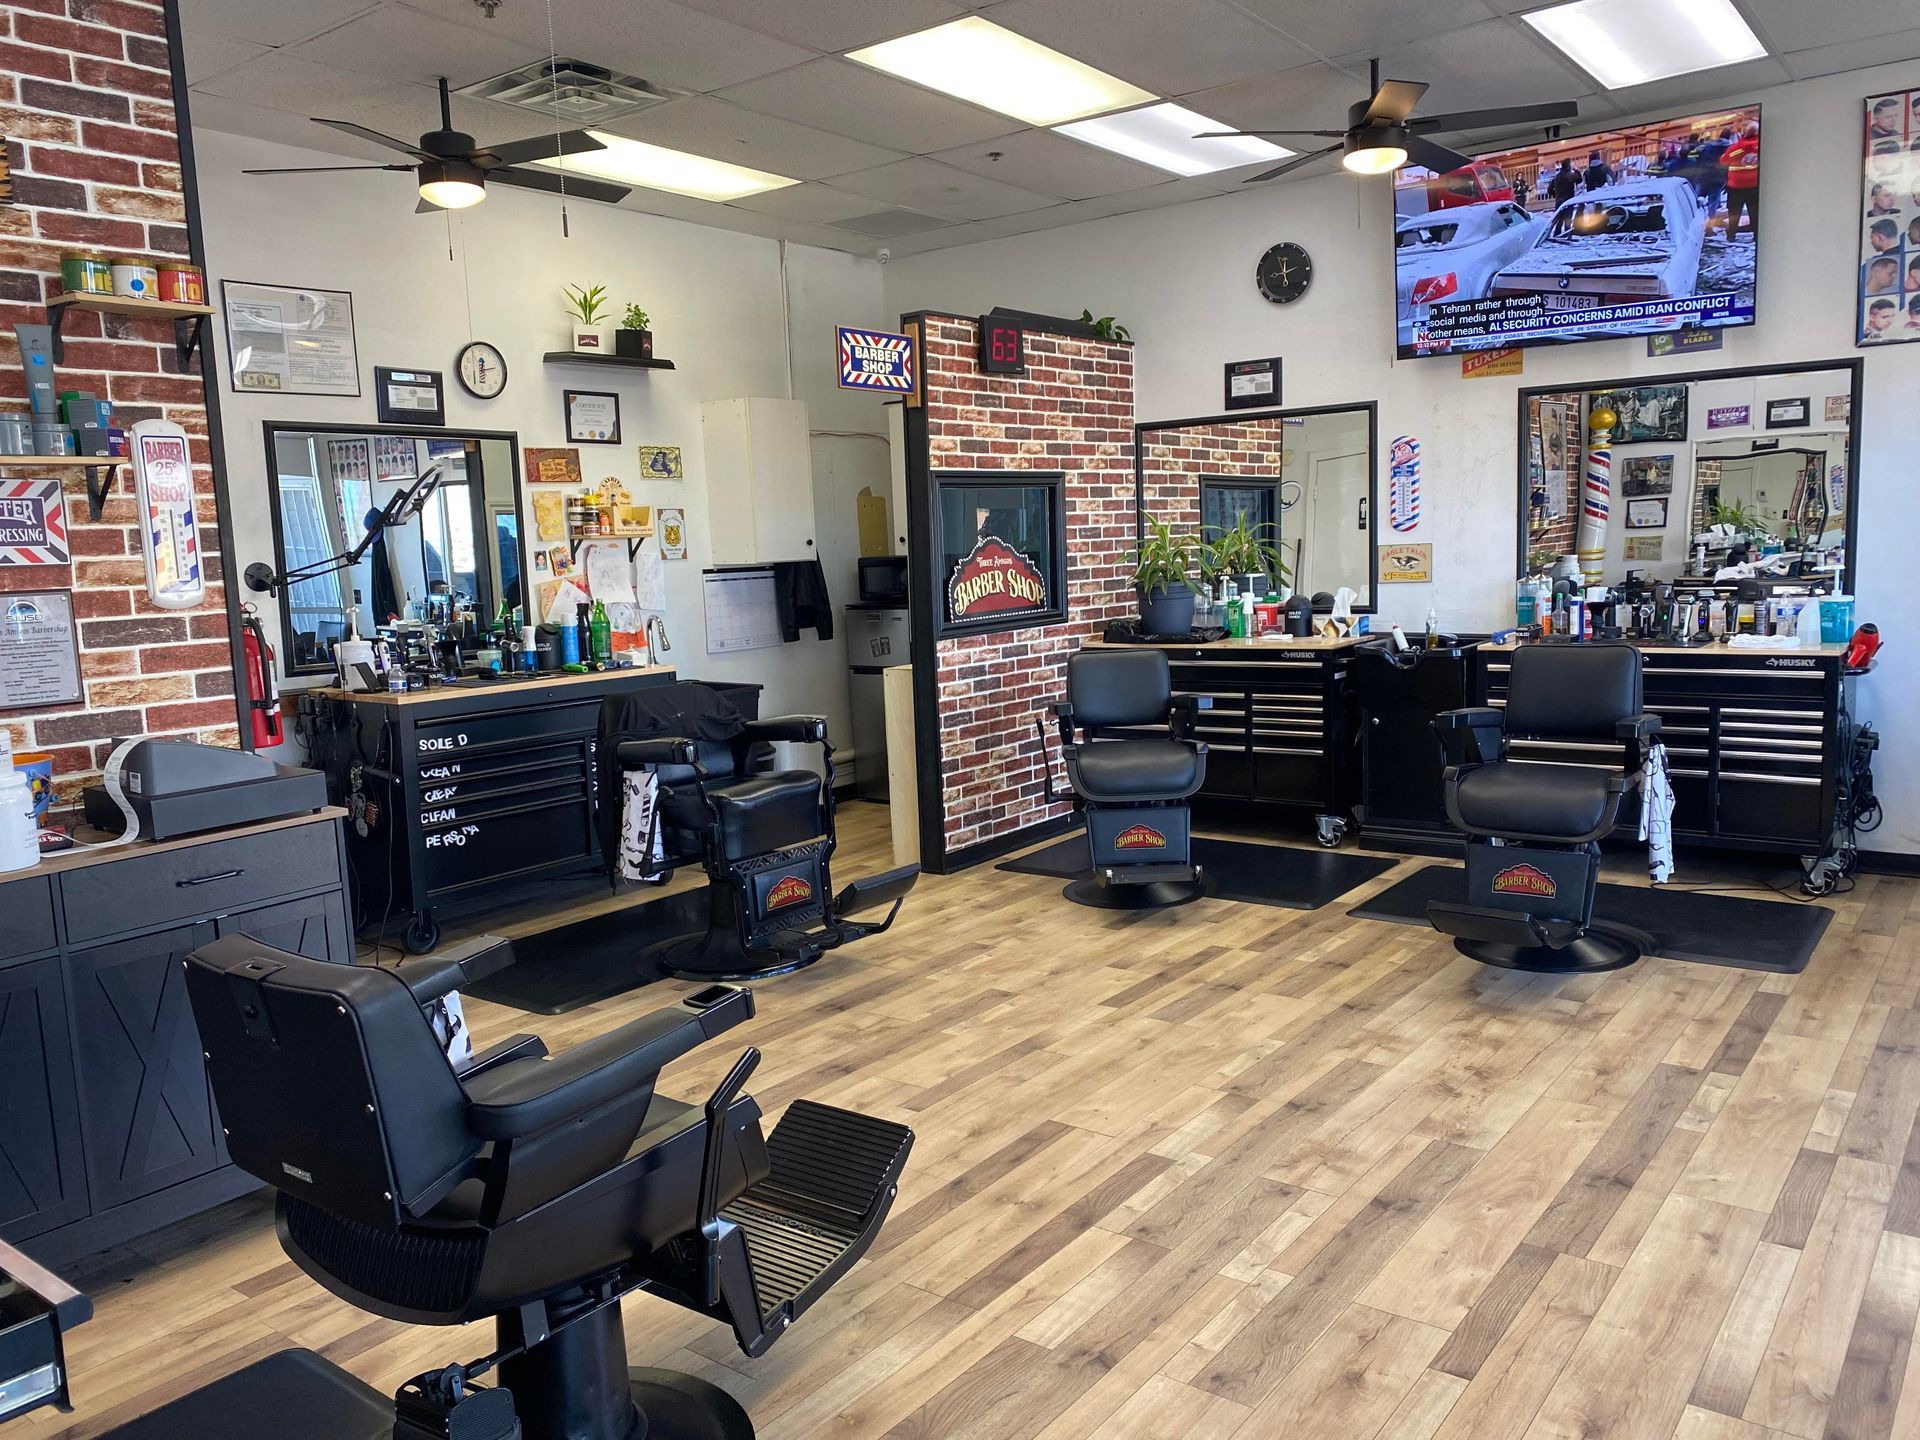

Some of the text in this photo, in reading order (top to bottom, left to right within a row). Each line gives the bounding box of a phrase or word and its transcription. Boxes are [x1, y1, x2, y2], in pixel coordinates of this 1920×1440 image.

[1429, 295, 1541, 315] in Tehran rather through
[1555, 296, 1591, 309] 101483
[1430, 307, 1543, 327] social media and through
[1489, 322, 1501, 332] AL
[1503, 317, 1551, 330] SECURITY
[1553, 310, 1612, 324] CONCERNS
[1614, 303, 1643, 319] AMID
[1645, 300, 1673, 315] IRAN
[1674, 296, 1730, 312] CONFLICT
[1430, 330, 1451, 339] other
[1454, 326, 1486, 337] means,
[1527, 329, 1559, 337] INCLUDING
[1683, 335, 1713, 344] BLADES
[992, 328, 1017, 362] 63
[854, 346, 899, 363] BARBER
[862, 359, 893, 374] SHOP
[144, 440, 184, 464] BARBER
[149, 482, 187, 503] SHOP
[976, 555, 1013, 568] THREE AMIGOS
[1382, 546, 1427, 561] EAGLE TALON
[953, 568, 1045, 616] BARBER SHOP
[1290, 651, 1315, 659] HUSKY
[1778, 658, 1816, 667] HUSKY
[1116, 833, 1165, 848] BARBER SHOP
[1495, 875, 1555, 896] BARBER SHOP
[768, 884, 810, 908] BARBER SHOP
